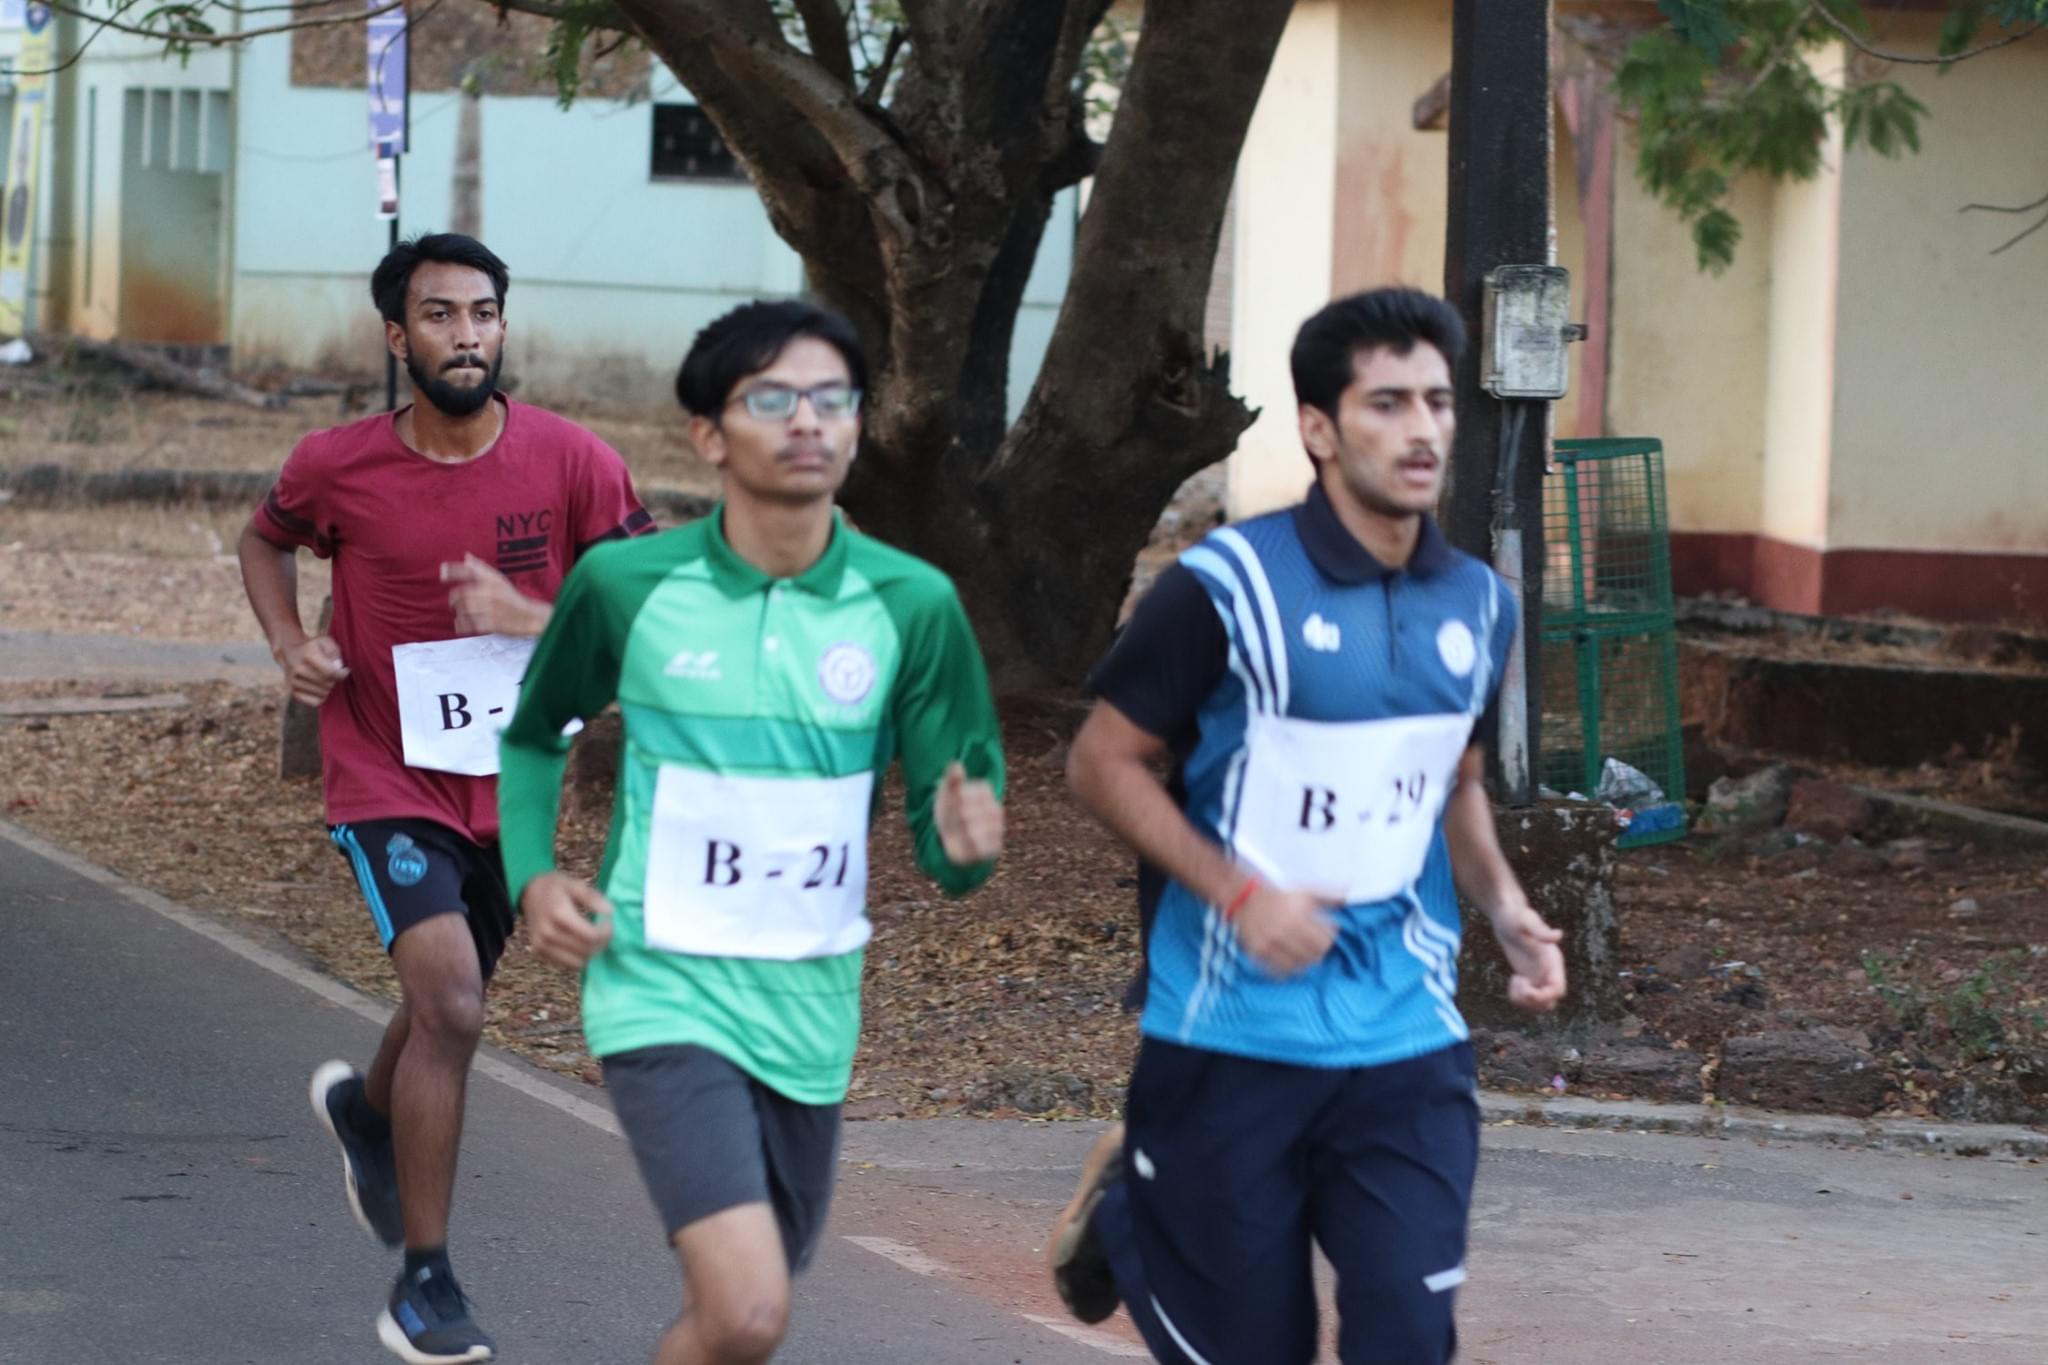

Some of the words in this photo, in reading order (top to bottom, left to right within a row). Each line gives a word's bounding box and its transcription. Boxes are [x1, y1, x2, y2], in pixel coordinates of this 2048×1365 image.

[496, 509, 552, 537] NYC
[437, 692, 473, 731] B
[1300, 786, 1336, 830] B
[704, 839, 742, 887] B
[803, 842, 849, 889] 21
